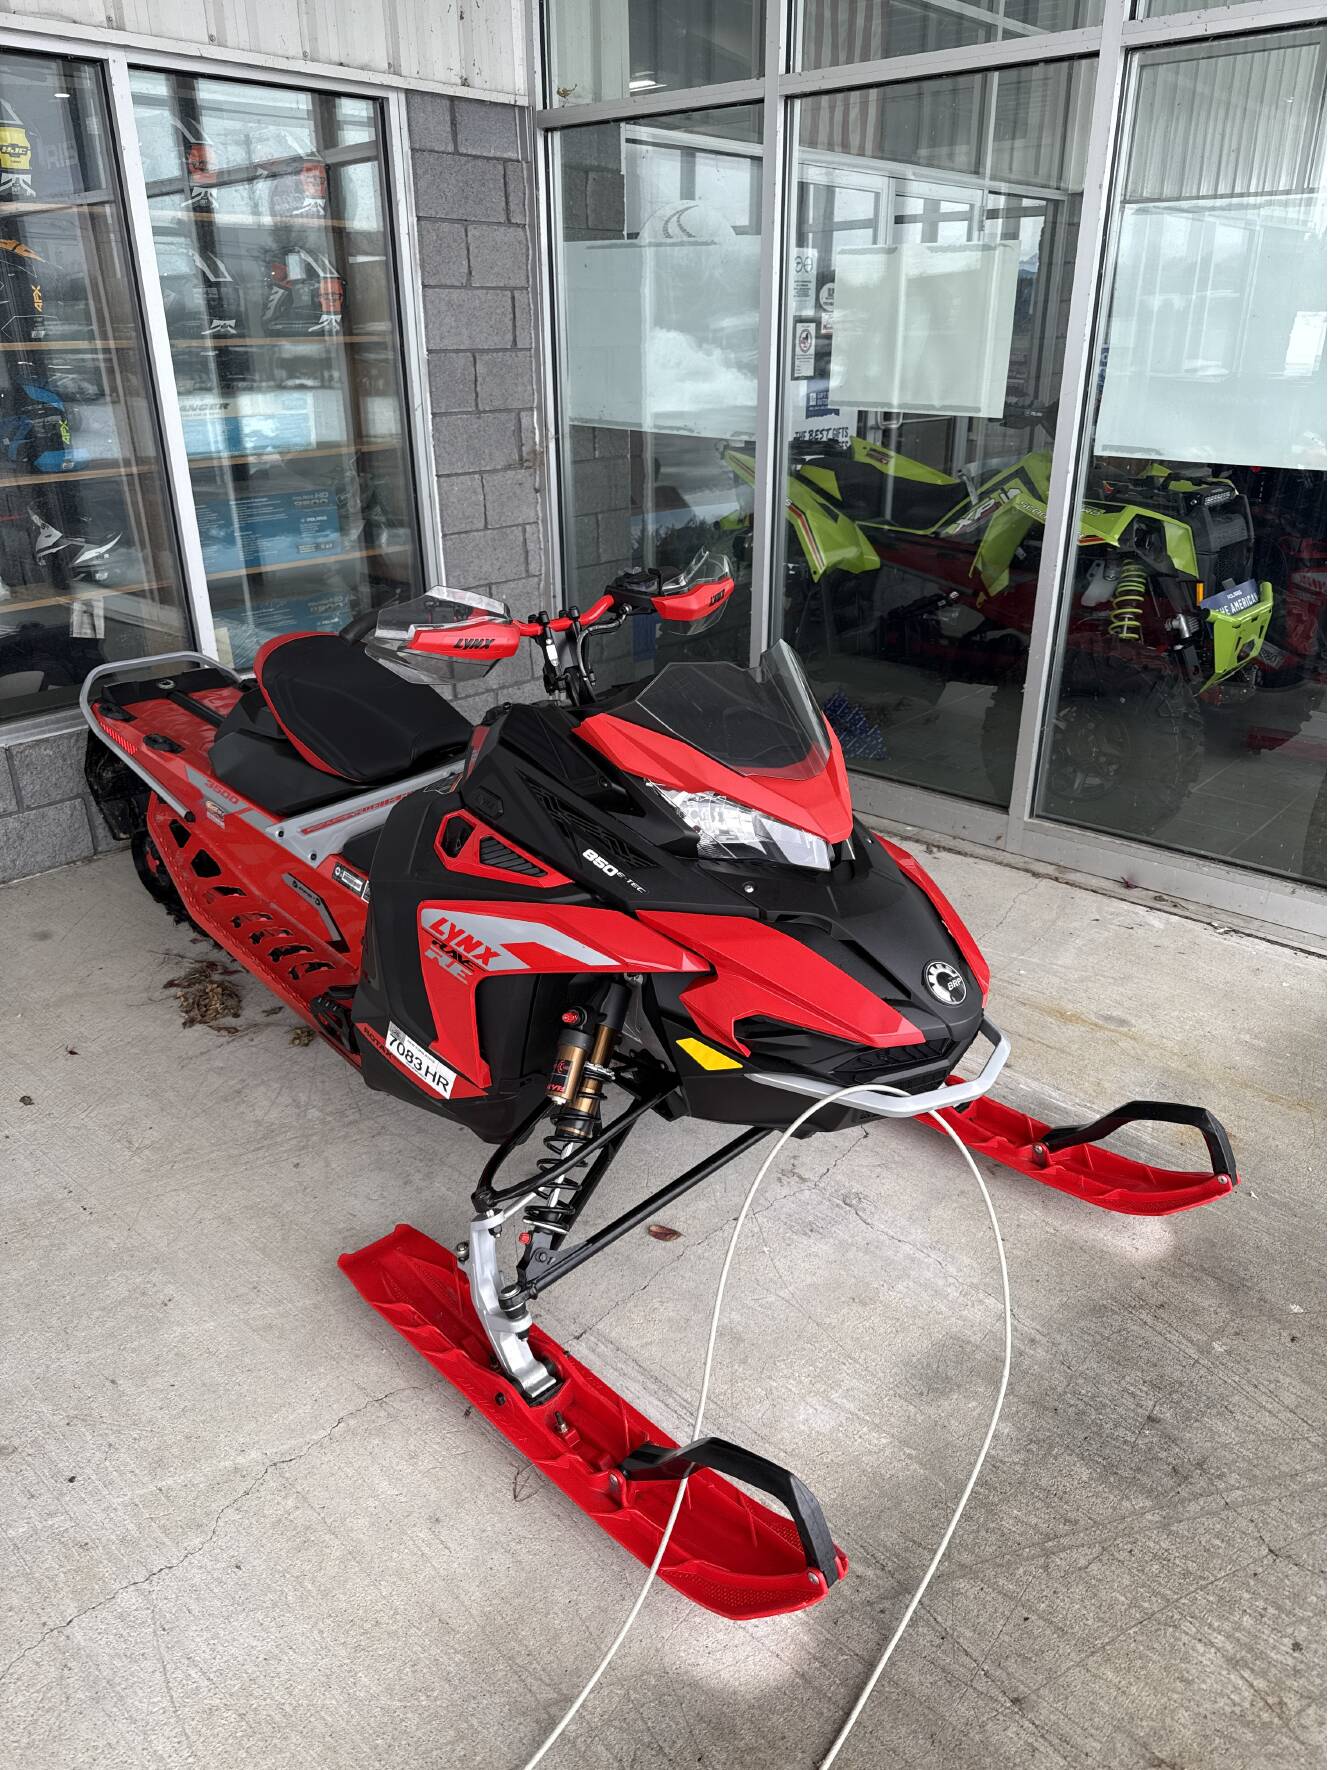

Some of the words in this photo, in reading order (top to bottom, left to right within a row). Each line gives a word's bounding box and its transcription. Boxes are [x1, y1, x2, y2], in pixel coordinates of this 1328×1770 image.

[32, 285, 43, 312] AFX
[59, 419, 70, 445] AFX
[808, 428, 832, 440] BEST
[453, 638, 496, 650] LYNX
[582, 848, 619, 877] 850
[428, 917, 502, 967] LYNX
[947, 977, 962, 991] BRP
[389, 1033, 423, 1072] 7083
[424, 1065, 450, 1094] HR
